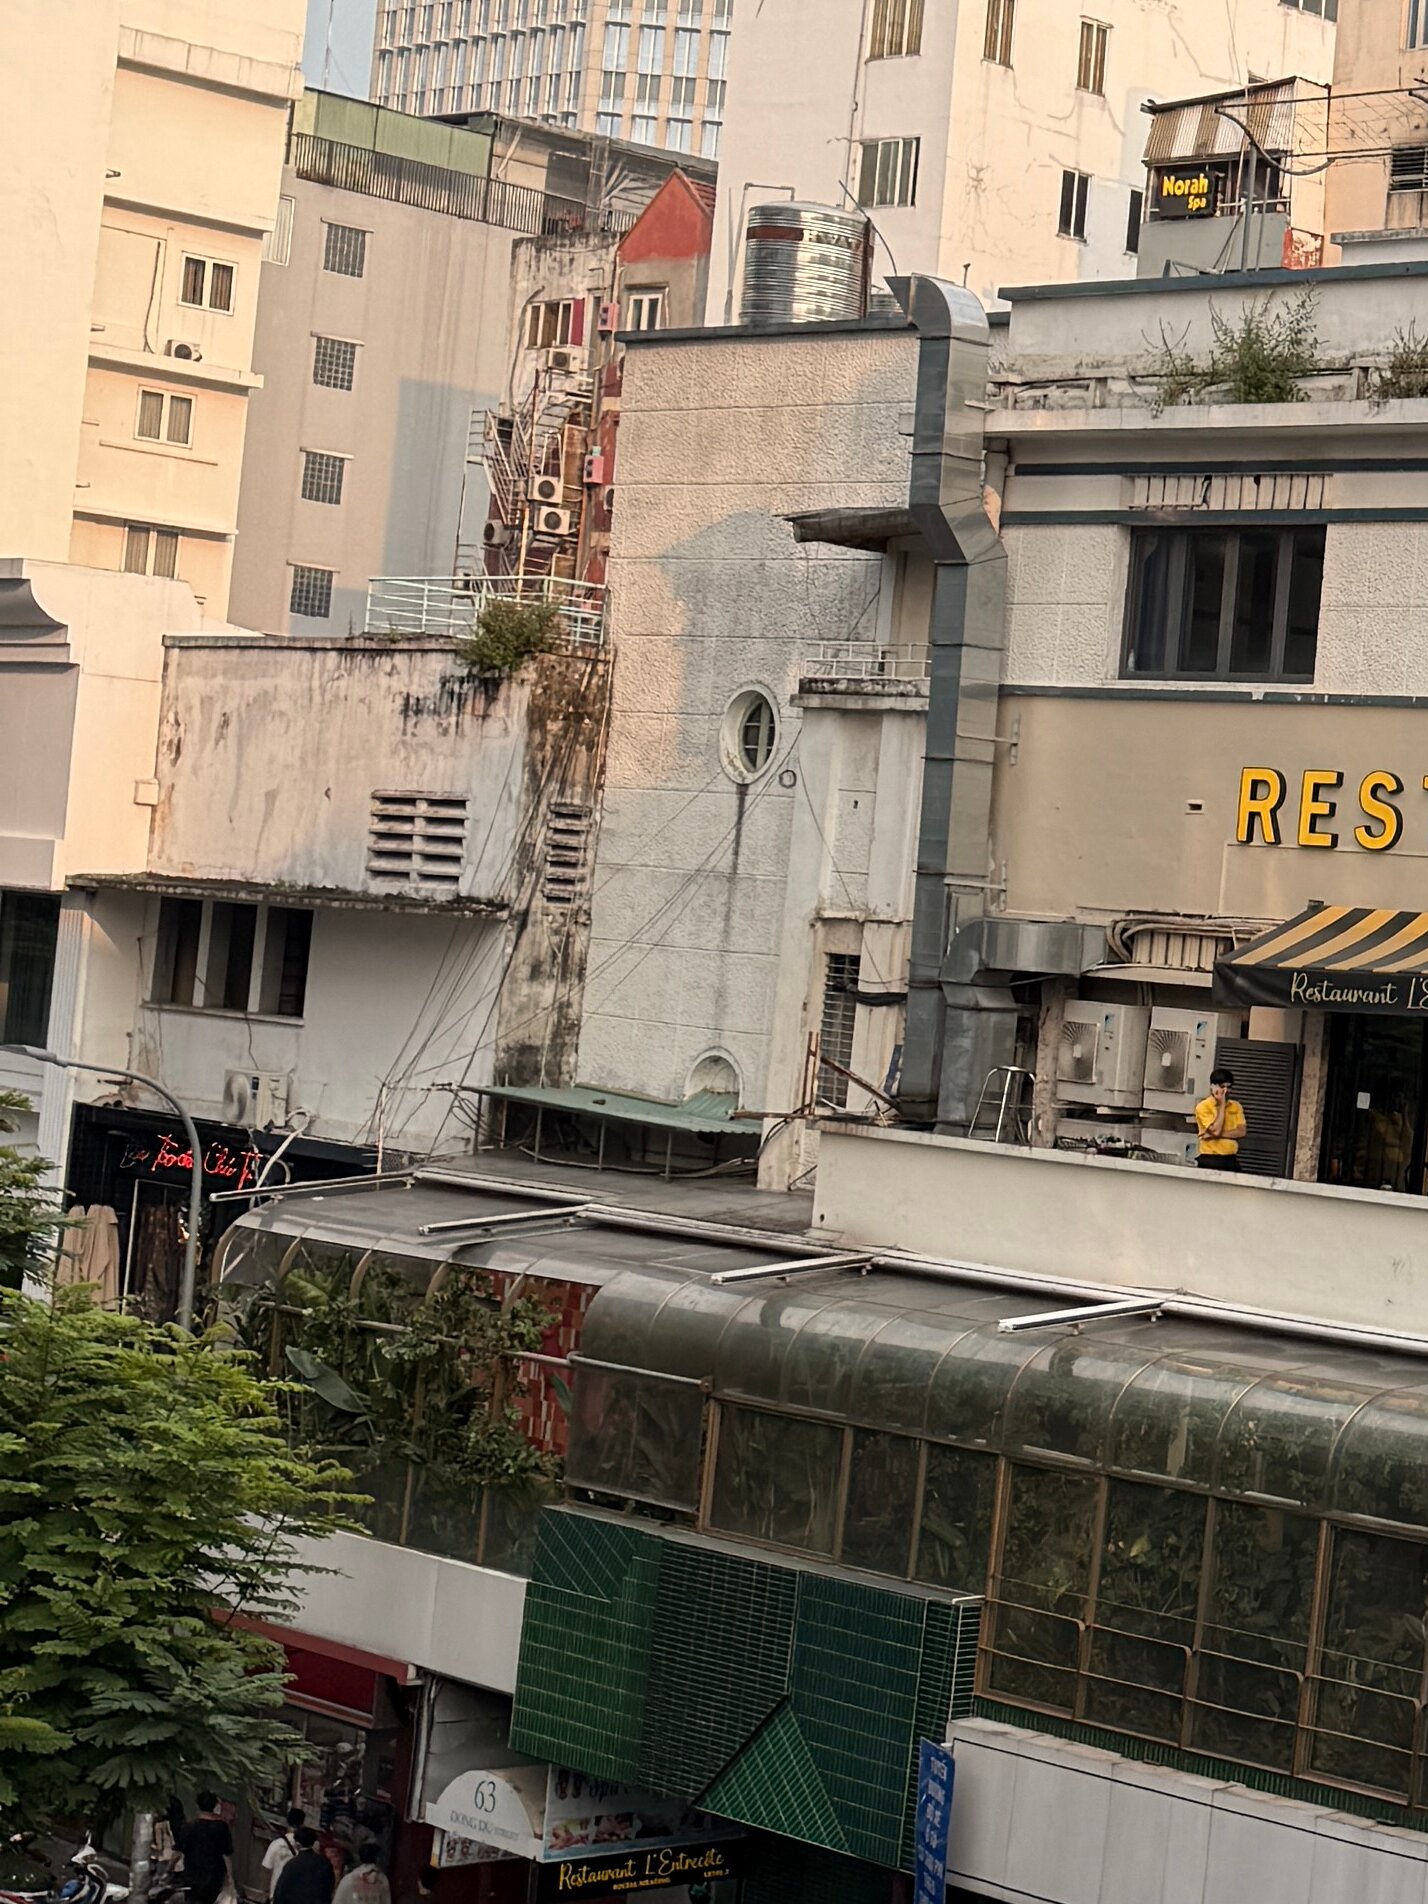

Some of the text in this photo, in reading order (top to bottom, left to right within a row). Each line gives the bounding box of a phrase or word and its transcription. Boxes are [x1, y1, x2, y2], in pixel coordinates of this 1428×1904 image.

[1162, 173, 1209, 196] Norah
[1187, 195, 1207, 211] Spa
[1290, 972, 1399, 1004] Restaurant
[474, 1780, 496, 1813] 63
[559, 1859, 637, 1891] Restaurant
